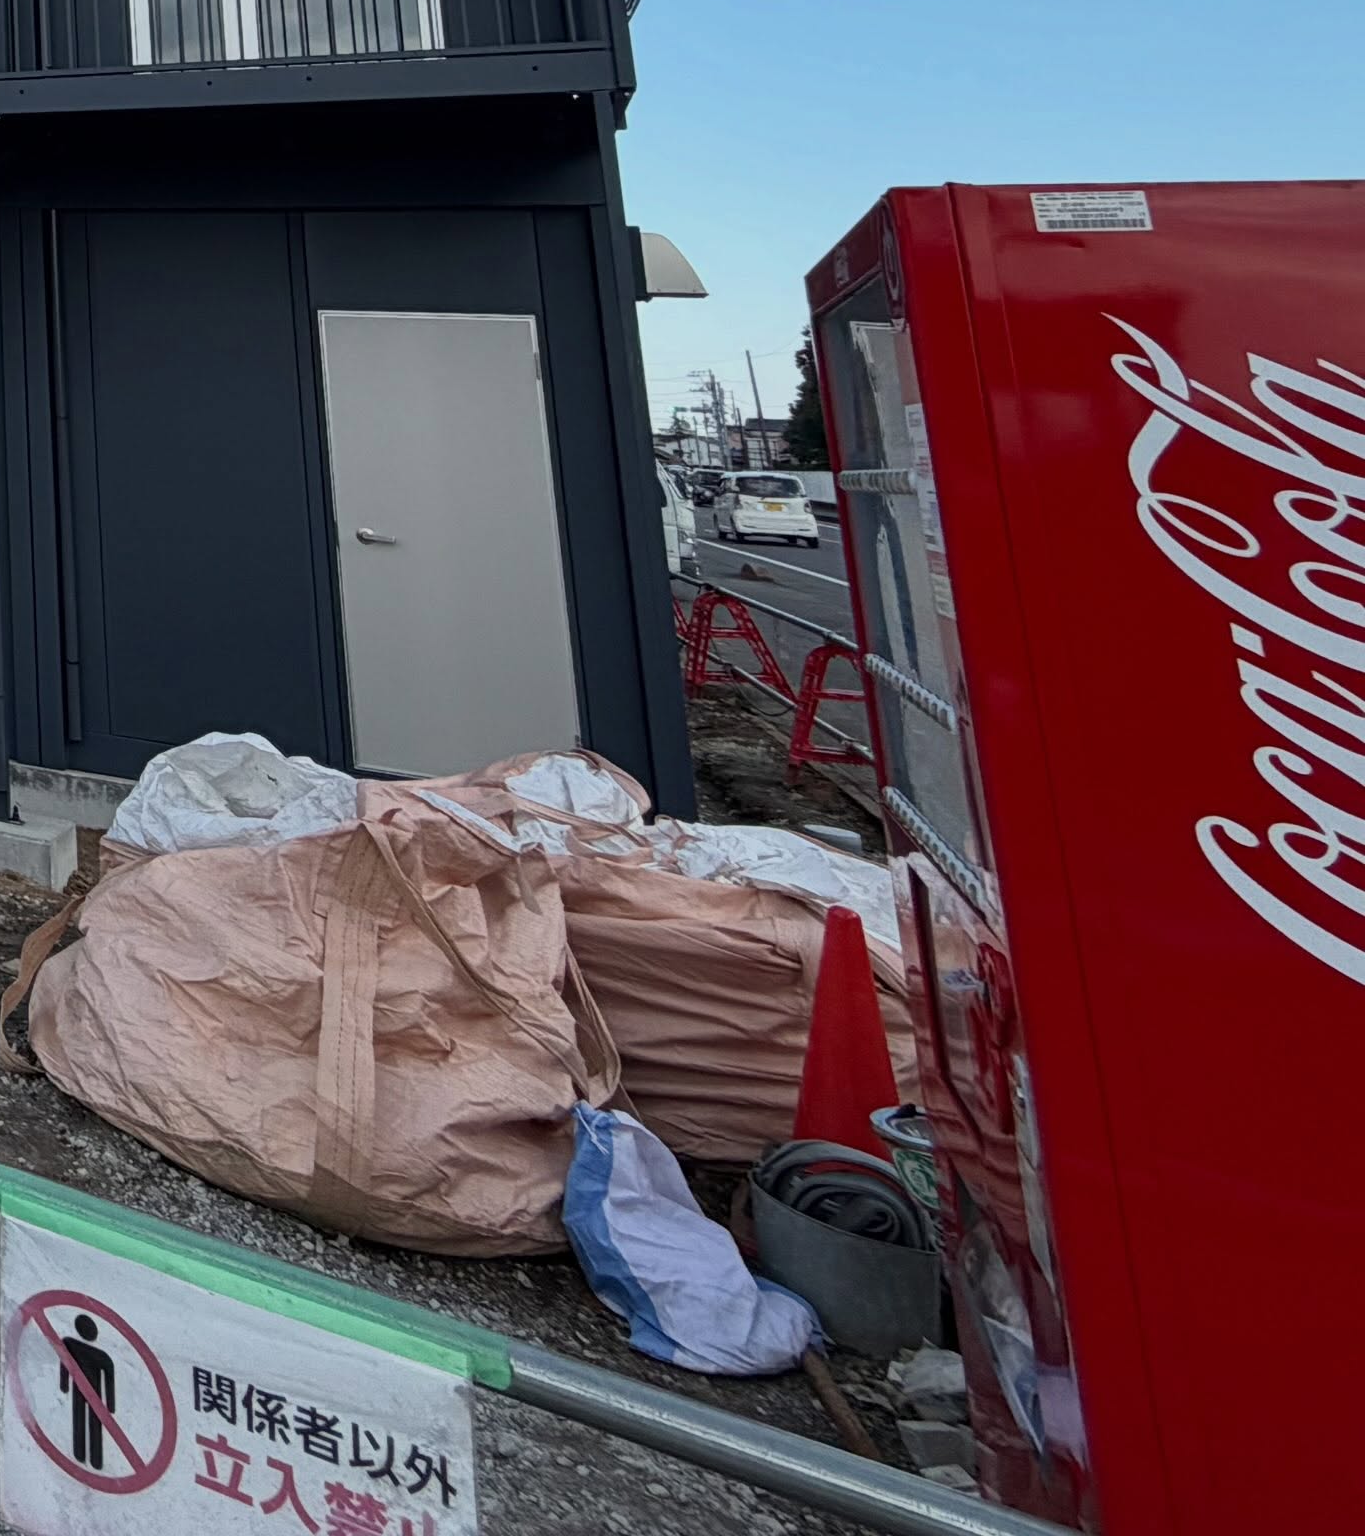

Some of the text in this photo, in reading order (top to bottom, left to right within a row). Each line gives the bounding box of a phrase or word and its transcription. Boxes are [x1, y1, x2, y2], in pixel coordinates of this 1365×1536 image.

[192, 1365, 457, 1508] 関係者以外
[194, 1433, 437, 1536] 立入禁
